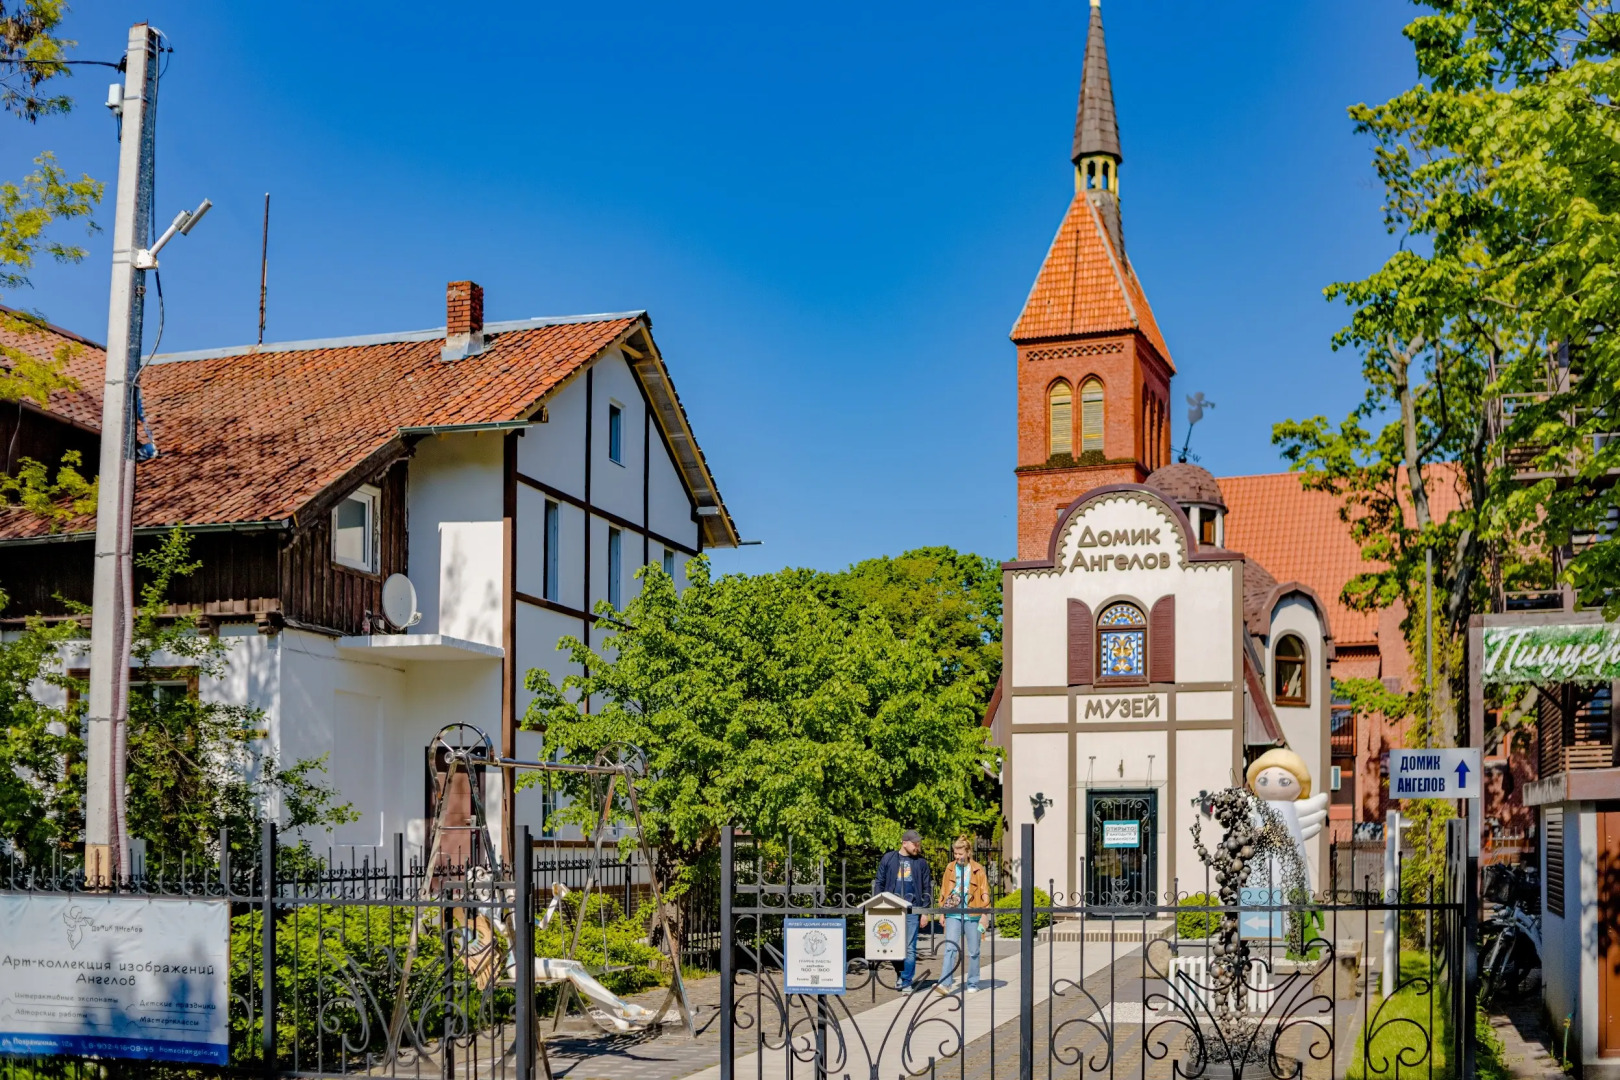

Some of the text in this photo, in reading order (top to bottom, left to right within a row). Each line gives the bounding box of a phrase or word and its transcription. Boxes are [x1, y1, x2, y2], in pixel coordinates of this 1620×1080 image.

[1077, 525, 1161, 548] Домик
[1069, 550, 1171, 572] Ангелов
[1084, 695, 1160, 719] МУЗЕЙ
[1400, 756, 1440, 772] ДОМИК
[1397, 777, 1446, 793] АНГЕЛОВ
[2, 955, 214, 976] Арт-коллекция изображений
[76, 973, 136, 986] Ангелов
[14, 992, 74, 1002] Интерактивные
[140, 1000, 172, 1008] Детские
[14, 1008, 56, 1017] Авторские
[140, 1016, 199, 1026] Мастер-классы
